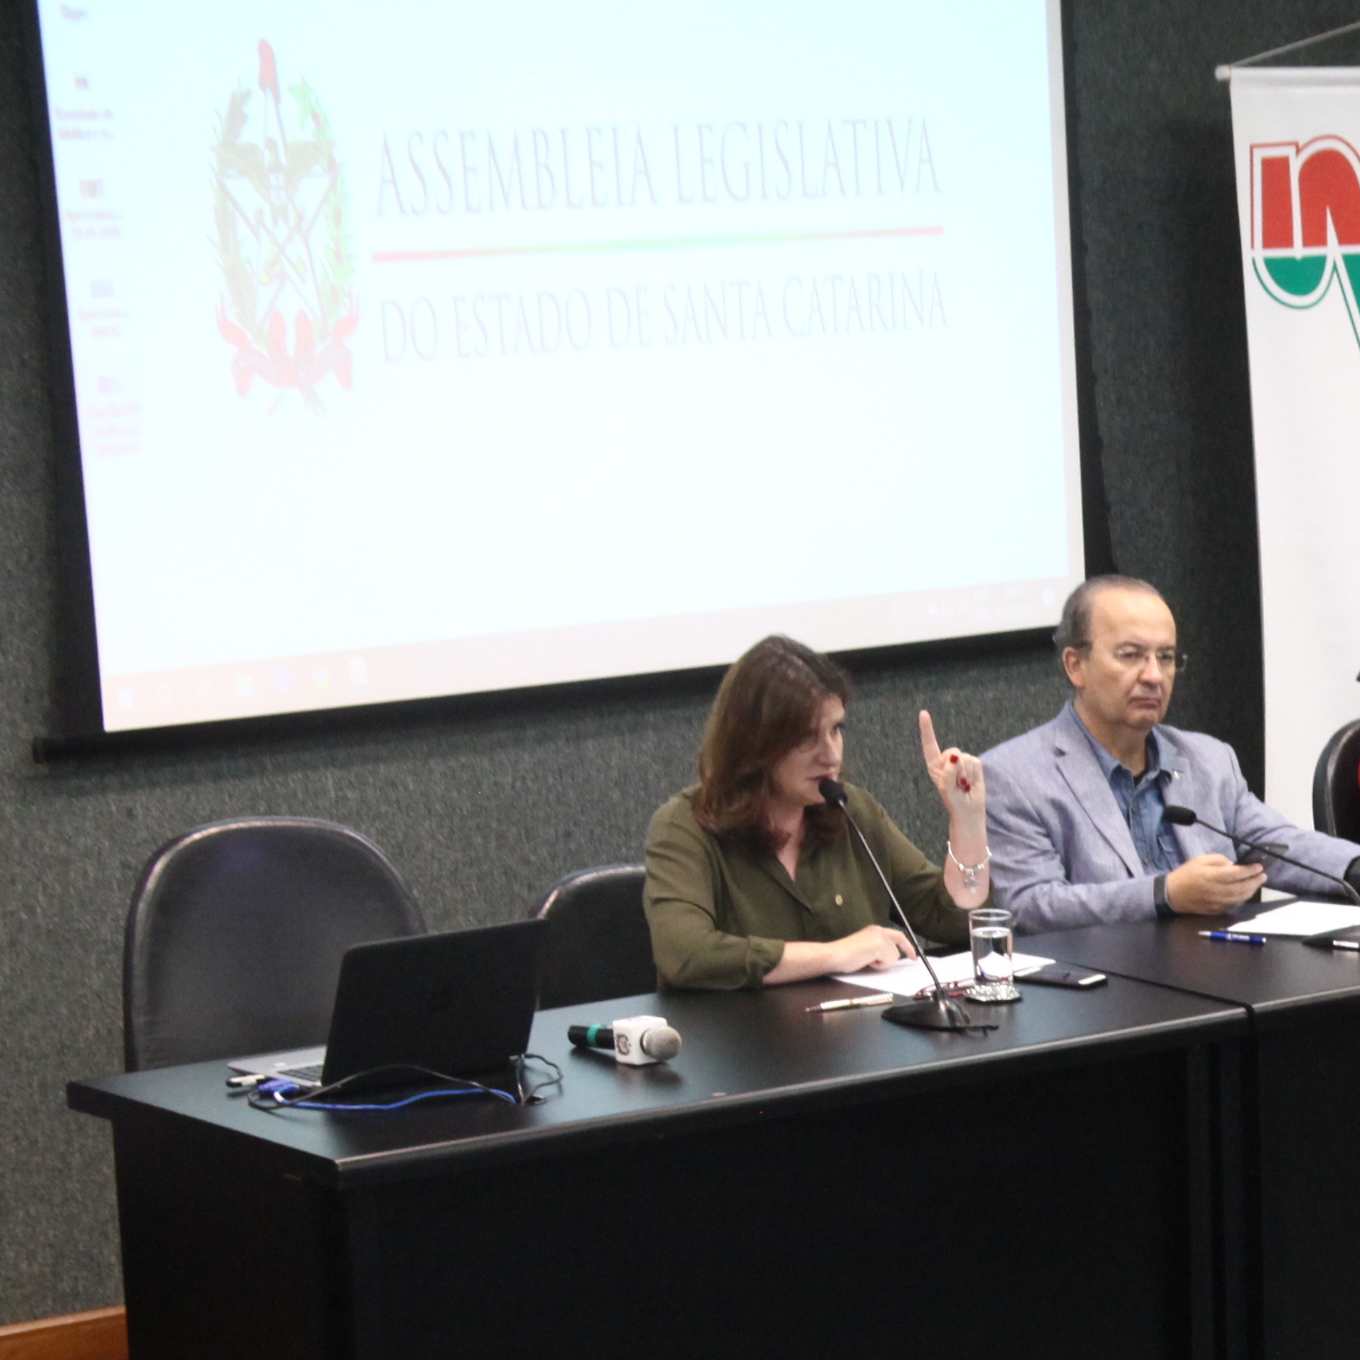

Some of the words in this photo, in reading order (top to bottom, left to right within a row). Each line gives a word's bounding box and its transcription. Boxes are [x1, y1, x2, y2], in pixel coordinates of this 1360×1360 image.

[376, 126, 659, 218] ASSEMBLEIA
[672, 117, 941, 204] LEGISLATIVA
[379, 295, 439, 364] DO
[452, 288, 592, 360] ESTADO
[606, 283, 650, 349] DE
[663, 278, 773, 345] SANTA
[782, 270, 949, 338] CATARINA
